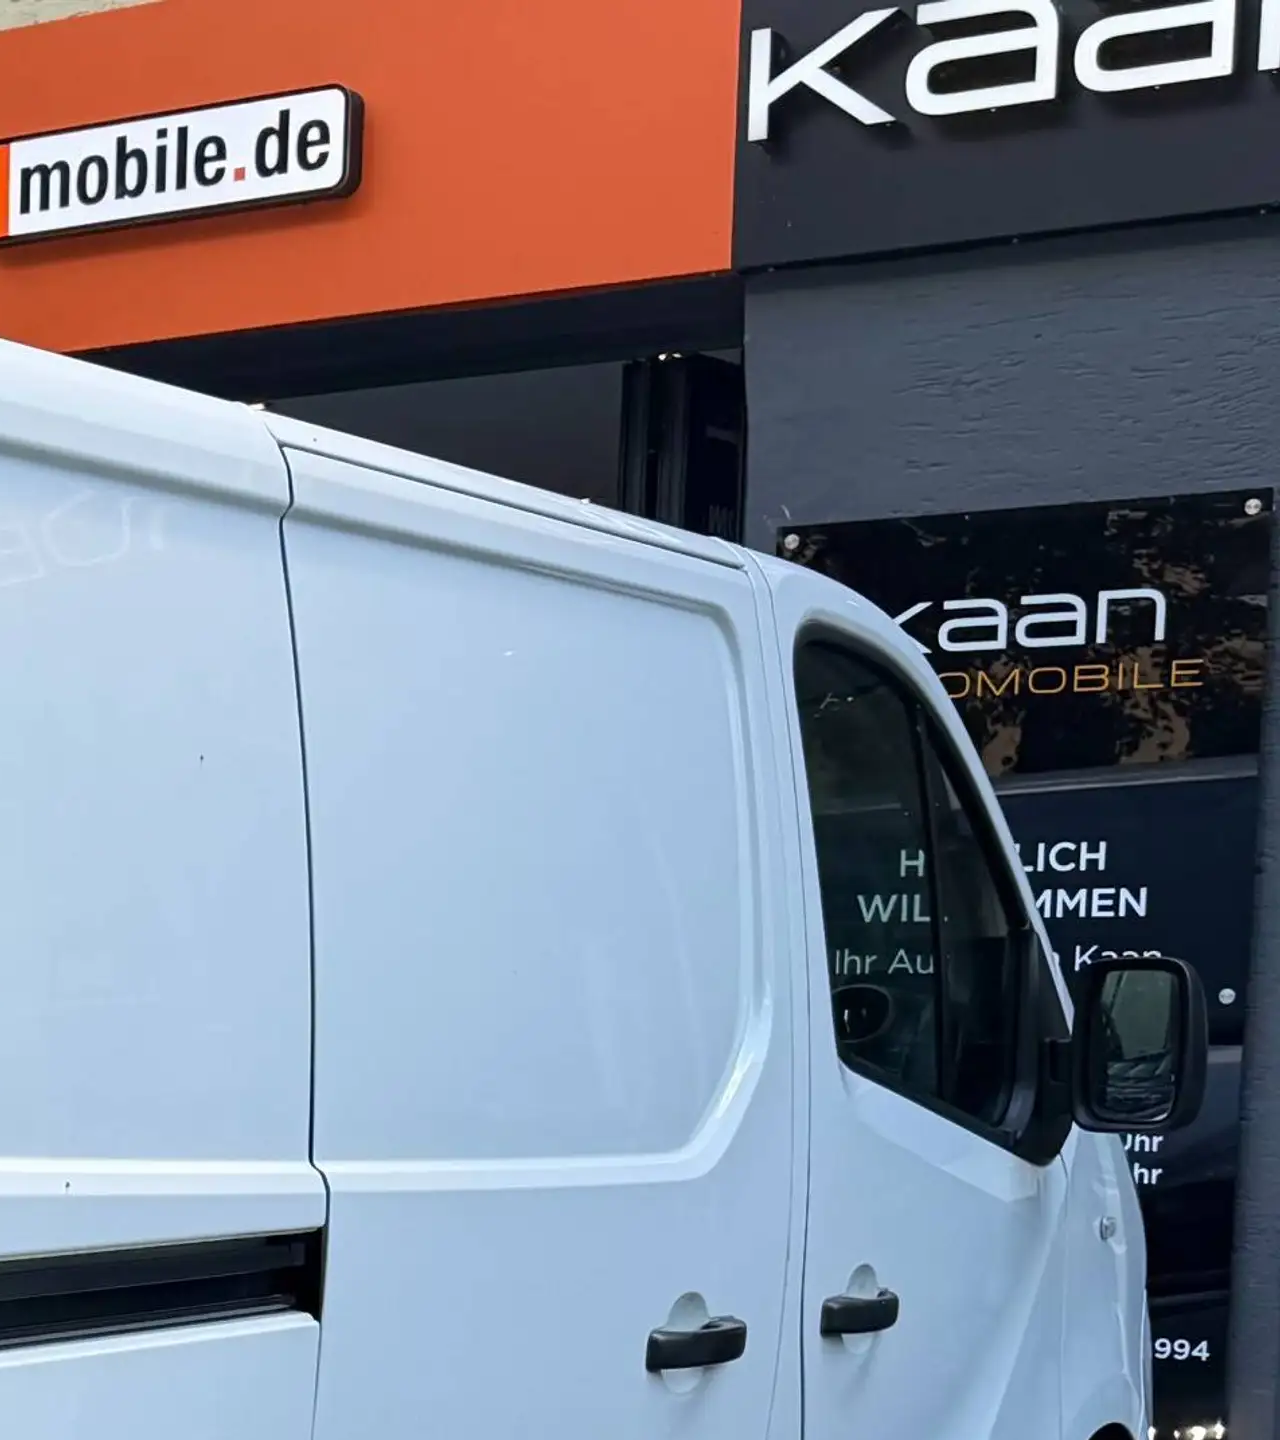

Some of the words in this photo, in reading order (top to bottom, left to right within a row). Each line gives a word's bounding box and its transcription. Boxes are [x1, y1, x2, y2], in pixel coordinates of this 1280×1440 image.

[747, 0, 1280, 143] kaa
[19, 109, 331, 215] mobile.de
[938, 658, 1205, 699] OMOBILE
[835, 948, 877, 975] Ihr
[1134, 1162, 1163, 1185] hr
[1154, 1338, 1209, 1362] 994
